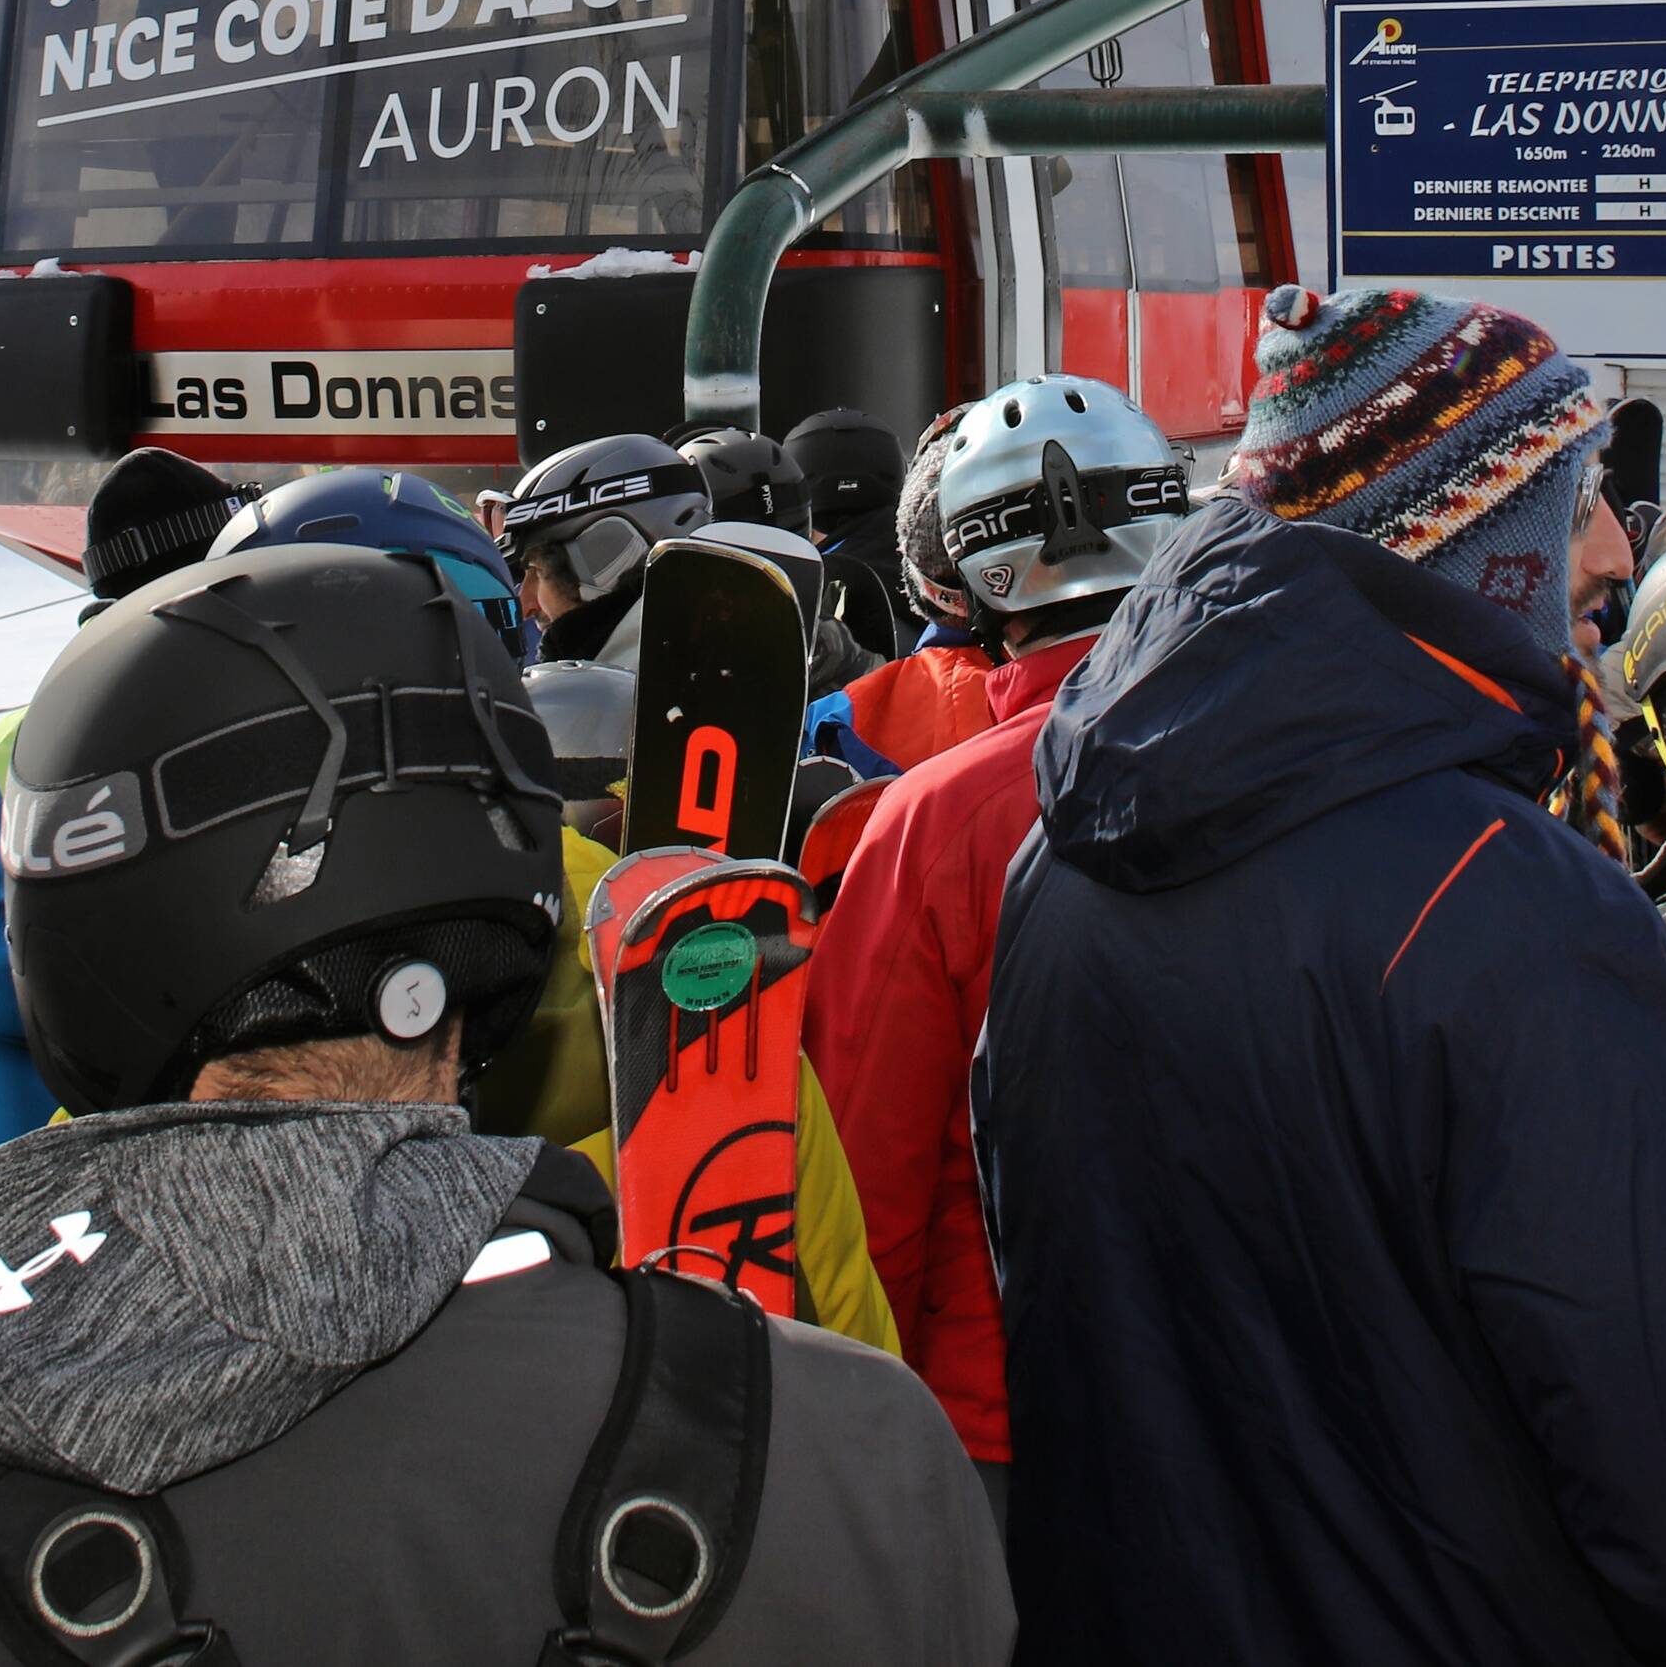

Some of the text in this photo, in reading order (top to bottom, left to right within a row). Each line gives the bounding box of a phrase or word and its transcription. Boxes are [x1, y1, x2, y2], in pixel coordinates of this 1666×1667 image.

[38, 7, 202, 96] NICE
[360, 55, 681, 168] AURON
[1470, 102, 1544, 137] LAS
[1515, 145, 1568, 161] 1650m
[1601, 143, 1656, 160] 2260m
[1413, 177, 1651, 196] DERNIERE REMONTEE H
[1413, 205, 1651, 222] DERNIERE DESCENTE H
[1492, 244, 1616, 270] PISTES
[139, 361, 516, 419] Las Donnas
[505, 475, 651, 525] SALICE
